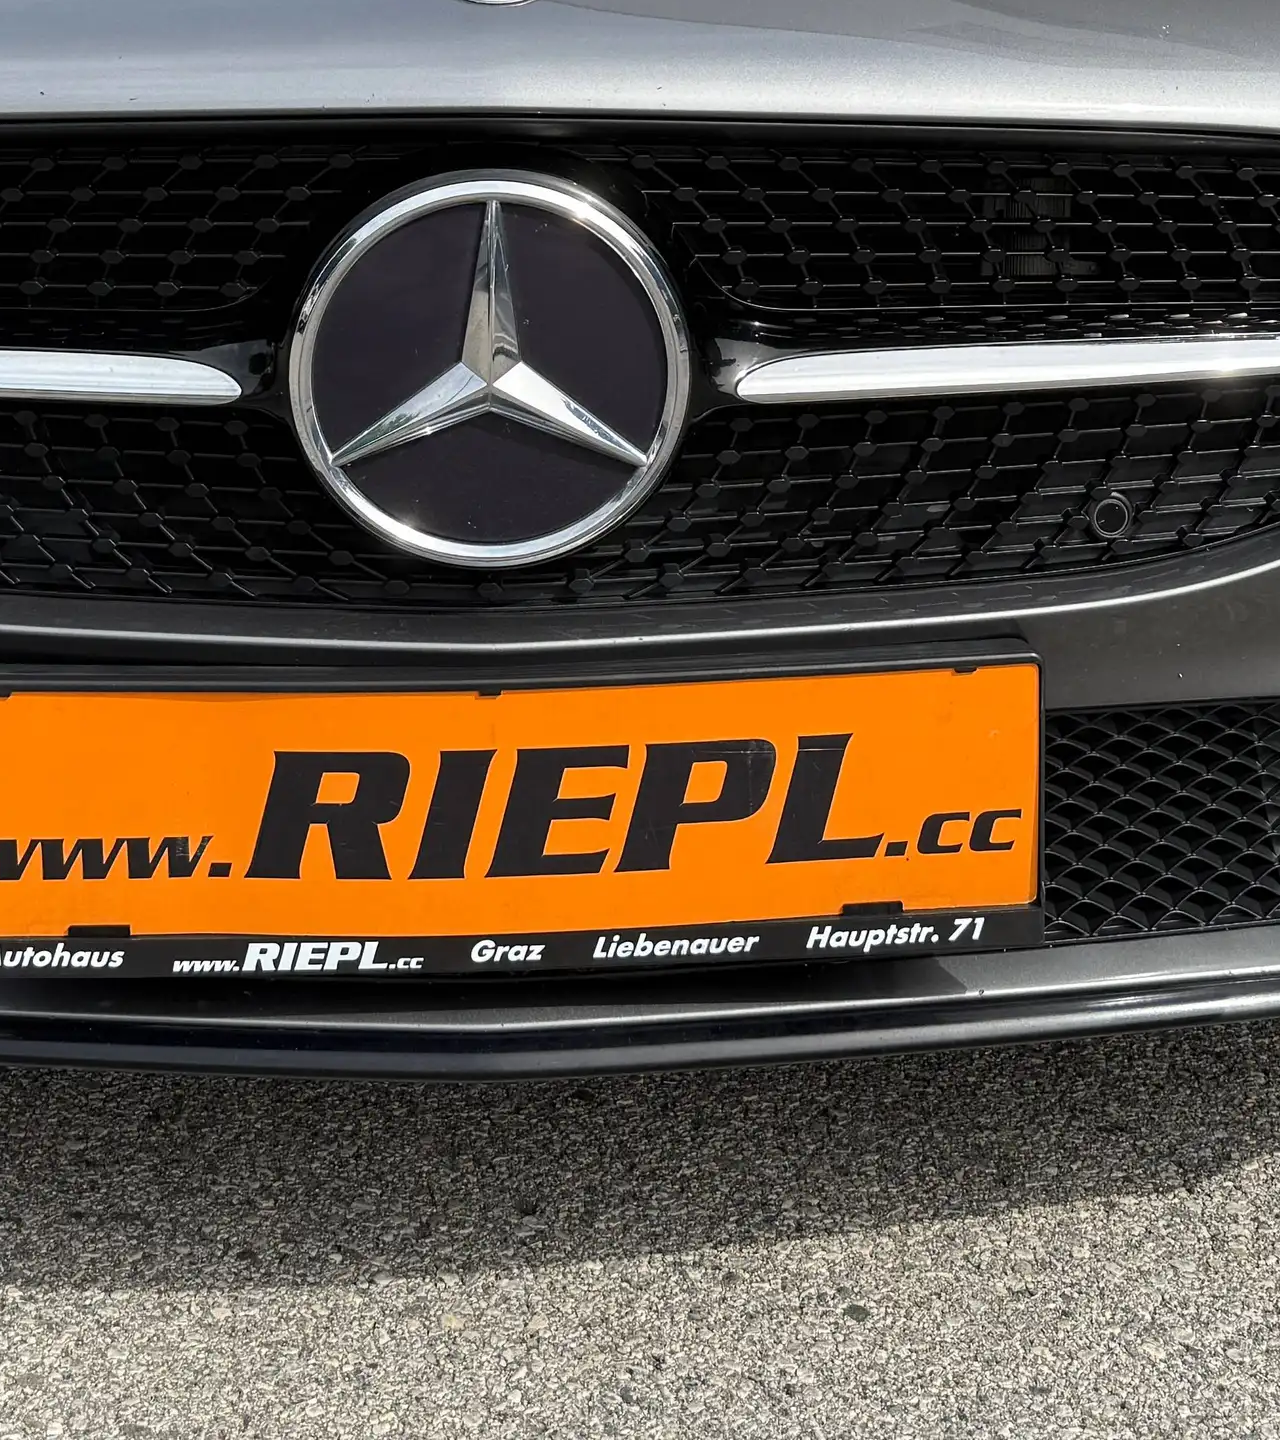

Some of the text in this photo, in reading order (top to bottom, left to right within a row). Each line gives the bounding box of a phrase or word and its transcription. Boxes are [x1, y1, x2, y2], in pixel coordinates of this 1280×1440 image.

[172, 940, 424, 973] www.RIEPL.cc
[469, 939, 546, 963] Graz
[592, 931, 760, 959] Liebenauer
[805, 922, 940, 951] Hauptstr.
[948, 916, 986, 942] 71
